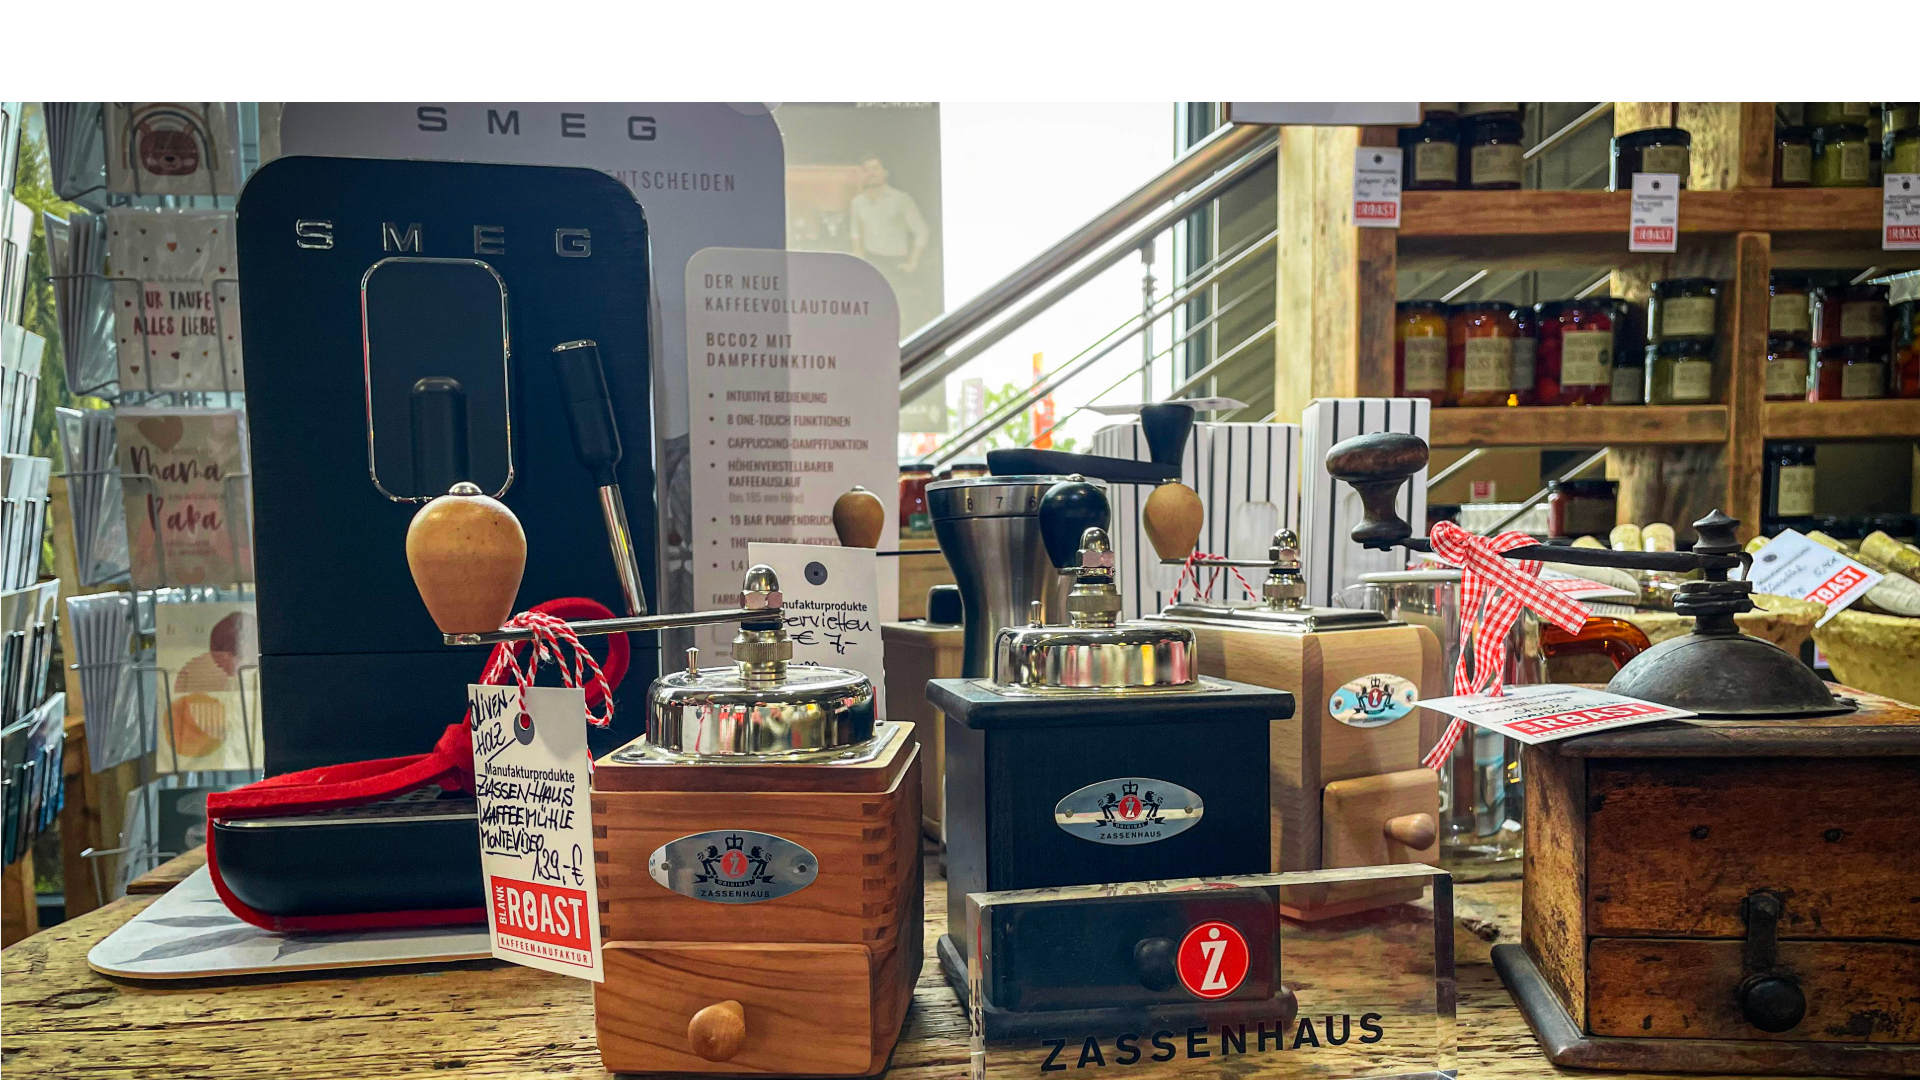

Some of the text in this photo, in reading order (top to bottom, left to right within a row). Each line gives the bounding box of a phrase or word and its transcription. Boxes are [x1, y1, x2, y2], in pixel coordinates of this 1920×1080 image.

[416, 106, 657, 141] SMEG
[606, 170, 735, 191] NTSCHEIDEN
[295, 218, 592, 258] SMEG
[704, 273, 780, 291] DER NEUE
[170, 291, 211, 310] TAUFE
[704, 297, 869, 316] KAFFEEVOLLAUTOMAT
[134, 316, 216, 337] ALLES LIEBE
[766, 334, 793, 349] MIT
[706, 352, 837, 370] DAMPFFUNKTION
[726, 390, 828, 403] INTUITIVE BEDIENUNG
[736, 414, 791, 427] ONE-TOUCH
[793, 415, 852, 427] FUNKTIONEN
[728, 457, 834, 473] HÖHENVERSTELLBARER
[728, 476, 802, 488] KAFFEEAUSLAUF
[967, 495, 1037, 511] 8 7 6
[744, 515, 762, 526] BAR
[781, 600, 868, 612] nufakturprodukte
[783, 611, 873, 632] ervietten
[484, 762, 575, 782] Manufakturprodukte
[1100, 831, 1162, 840] ZASSENHAUS
[701, 890, 770, 898] ZASSENHAUS
[496, 885, 508, 925] BLANK
[500, 936, 588, 963] KAFFEEMANUFAKTUR
[1041, 1011, 1384, 1072] ZASSENHAUS
